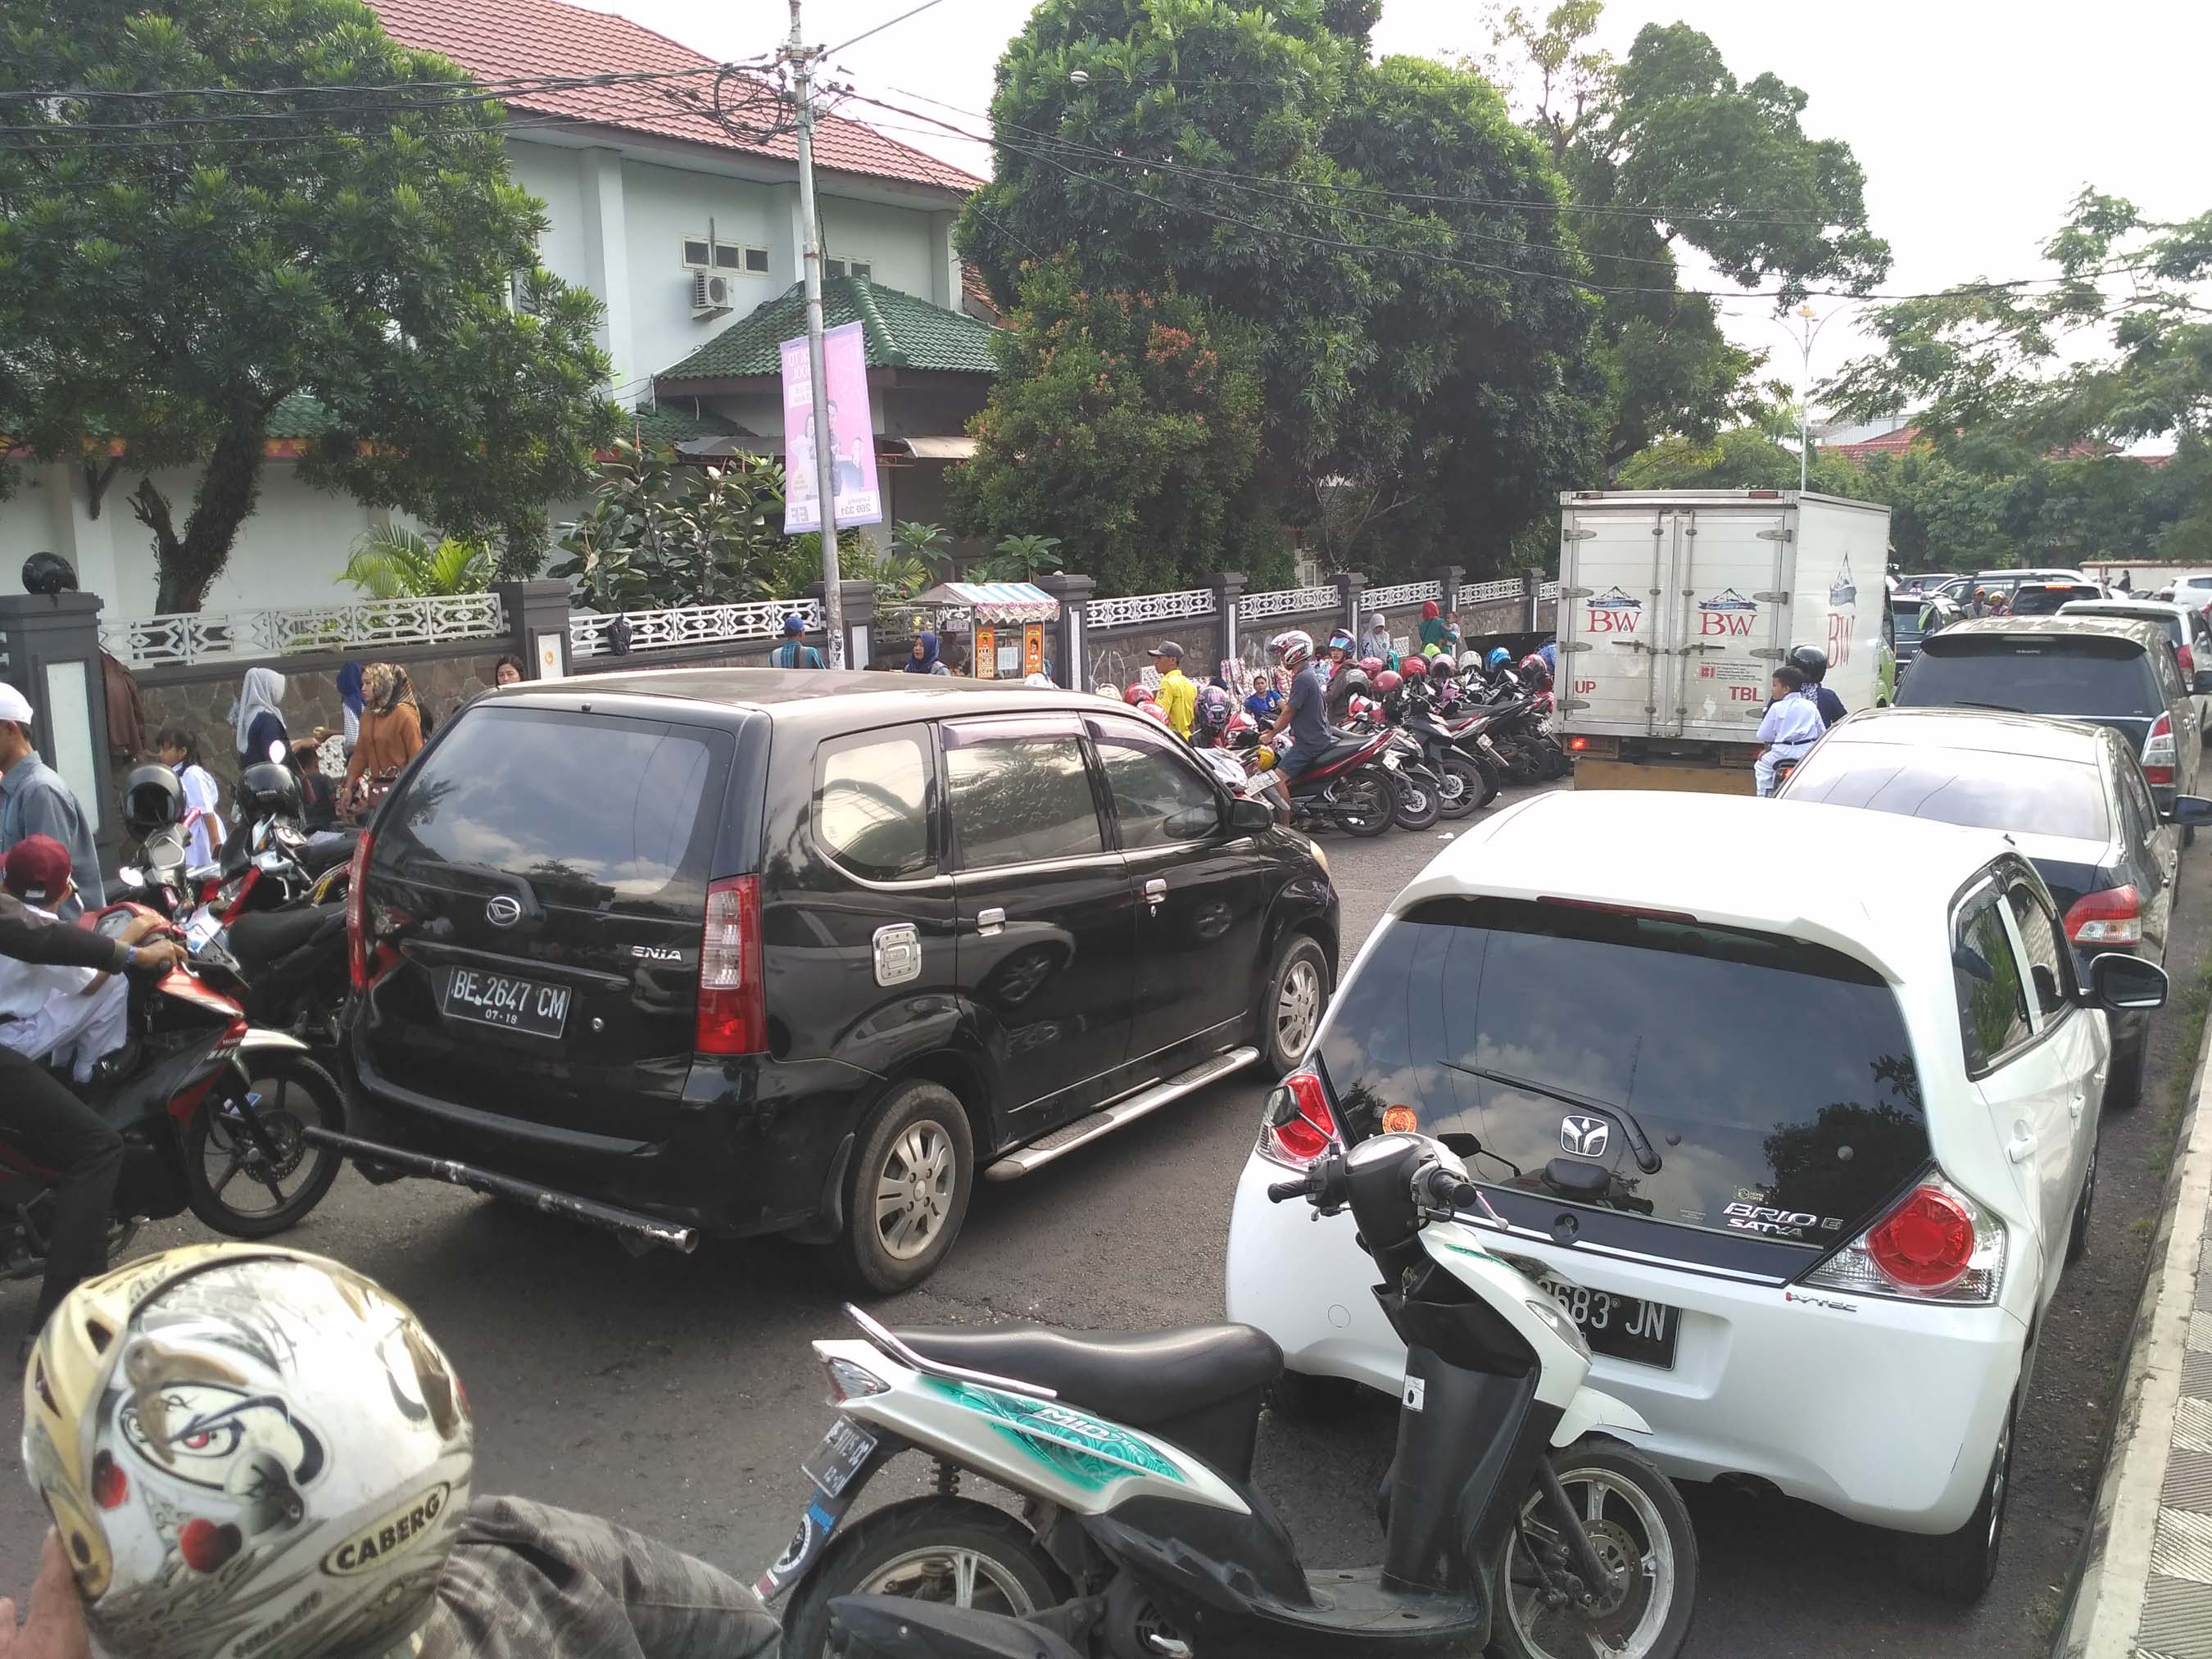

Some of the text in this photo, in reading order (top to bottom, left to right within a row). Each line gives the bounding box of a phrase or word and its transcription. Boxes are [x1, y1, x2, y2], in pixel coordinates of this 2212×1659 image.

[1586, 610, 1643, 633] BW
[1698, 612, 1757, 637] BW
[1827, 613, 1856, 669] BW
[1575, 680, 1597, 694] UP
[1729, 686, 1764, 703] TBL
[631, 945, 682, 962] ENIA
[453, 970, 566, 1020] BE 2647 CM
[1723, 1202, 1817, 1227] BRIO
[1820, 1217, 1843, 1230] E
[1727, 1218, 1803, 1238] SATYA
[1625, 1299, 1666, 1341] JN
[337, 1493, 440, 1570] CABERG
